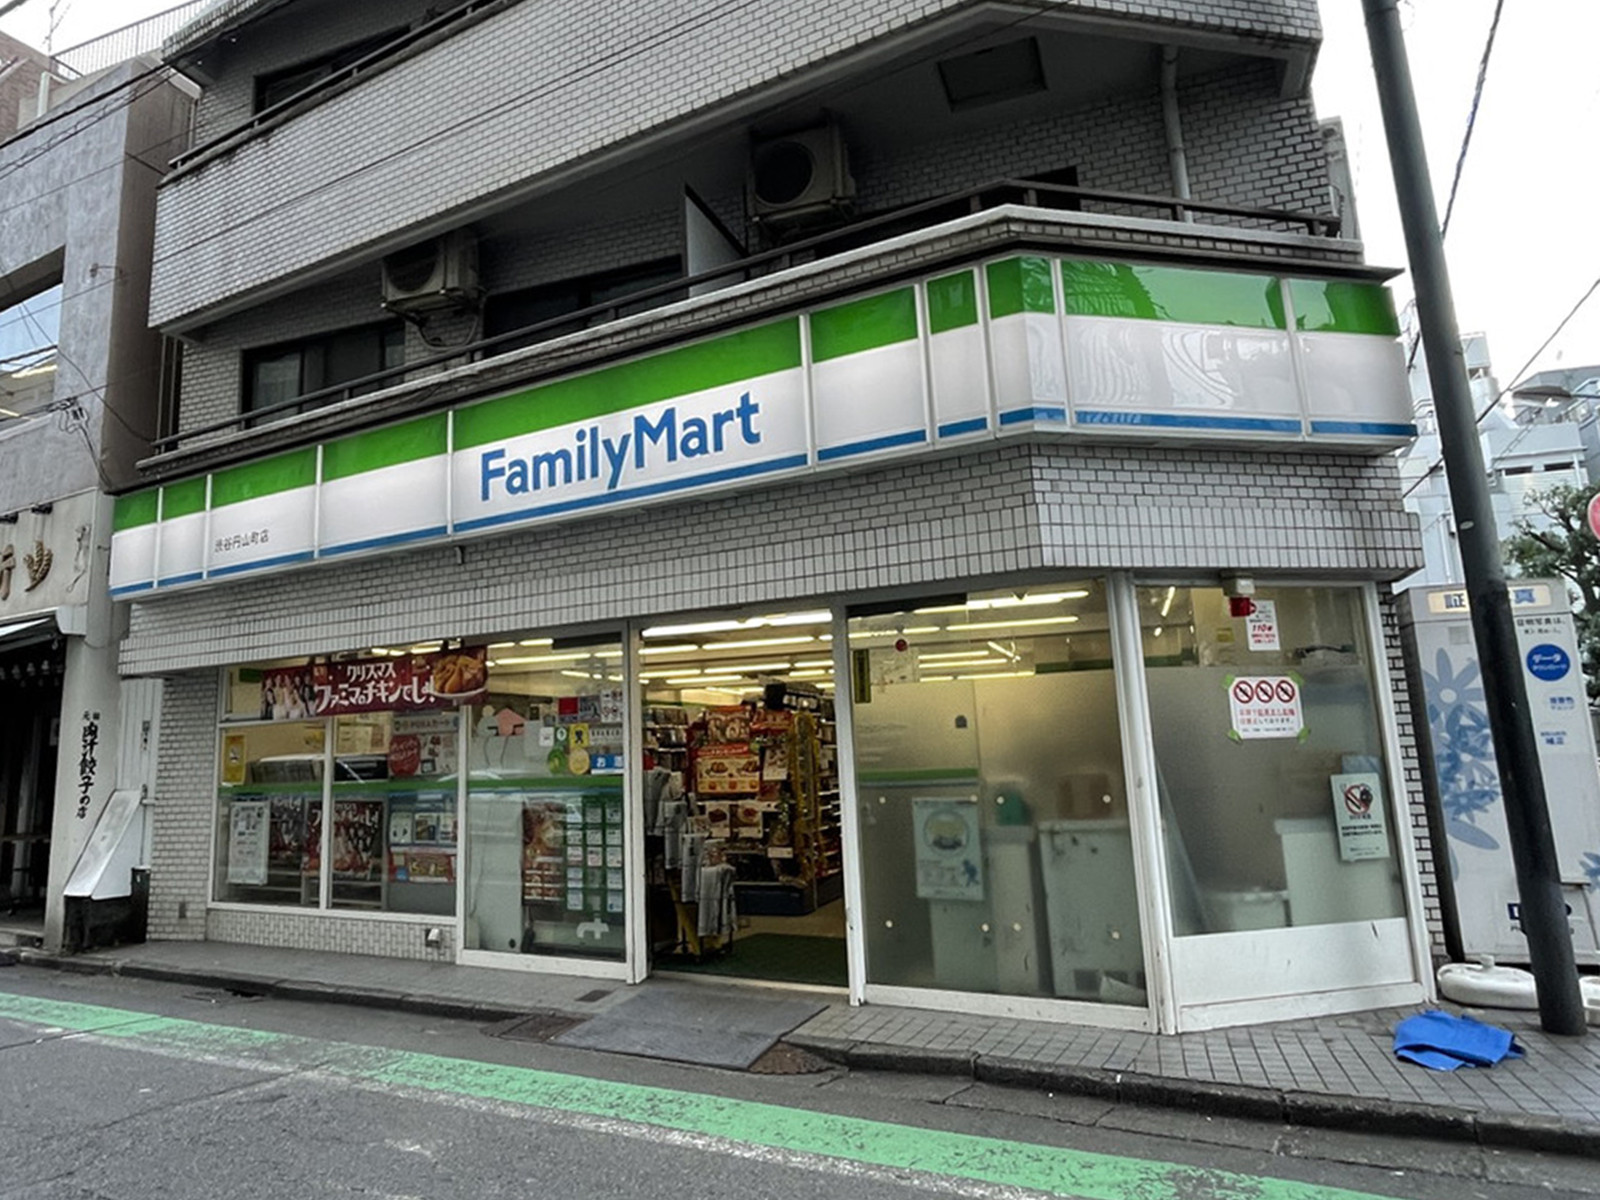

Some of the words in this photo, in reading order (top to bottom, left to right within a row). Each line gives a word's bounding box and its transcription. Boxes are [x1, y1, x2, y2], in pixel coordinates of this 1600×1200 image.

[481, 391, 761, 502] FamilyMart
[214, 528, 269, 553] 渋谷円山町店
[346, 661, 396, 682] クリスマス
[76, 720, 99, 820] 肉汁餃子の店
